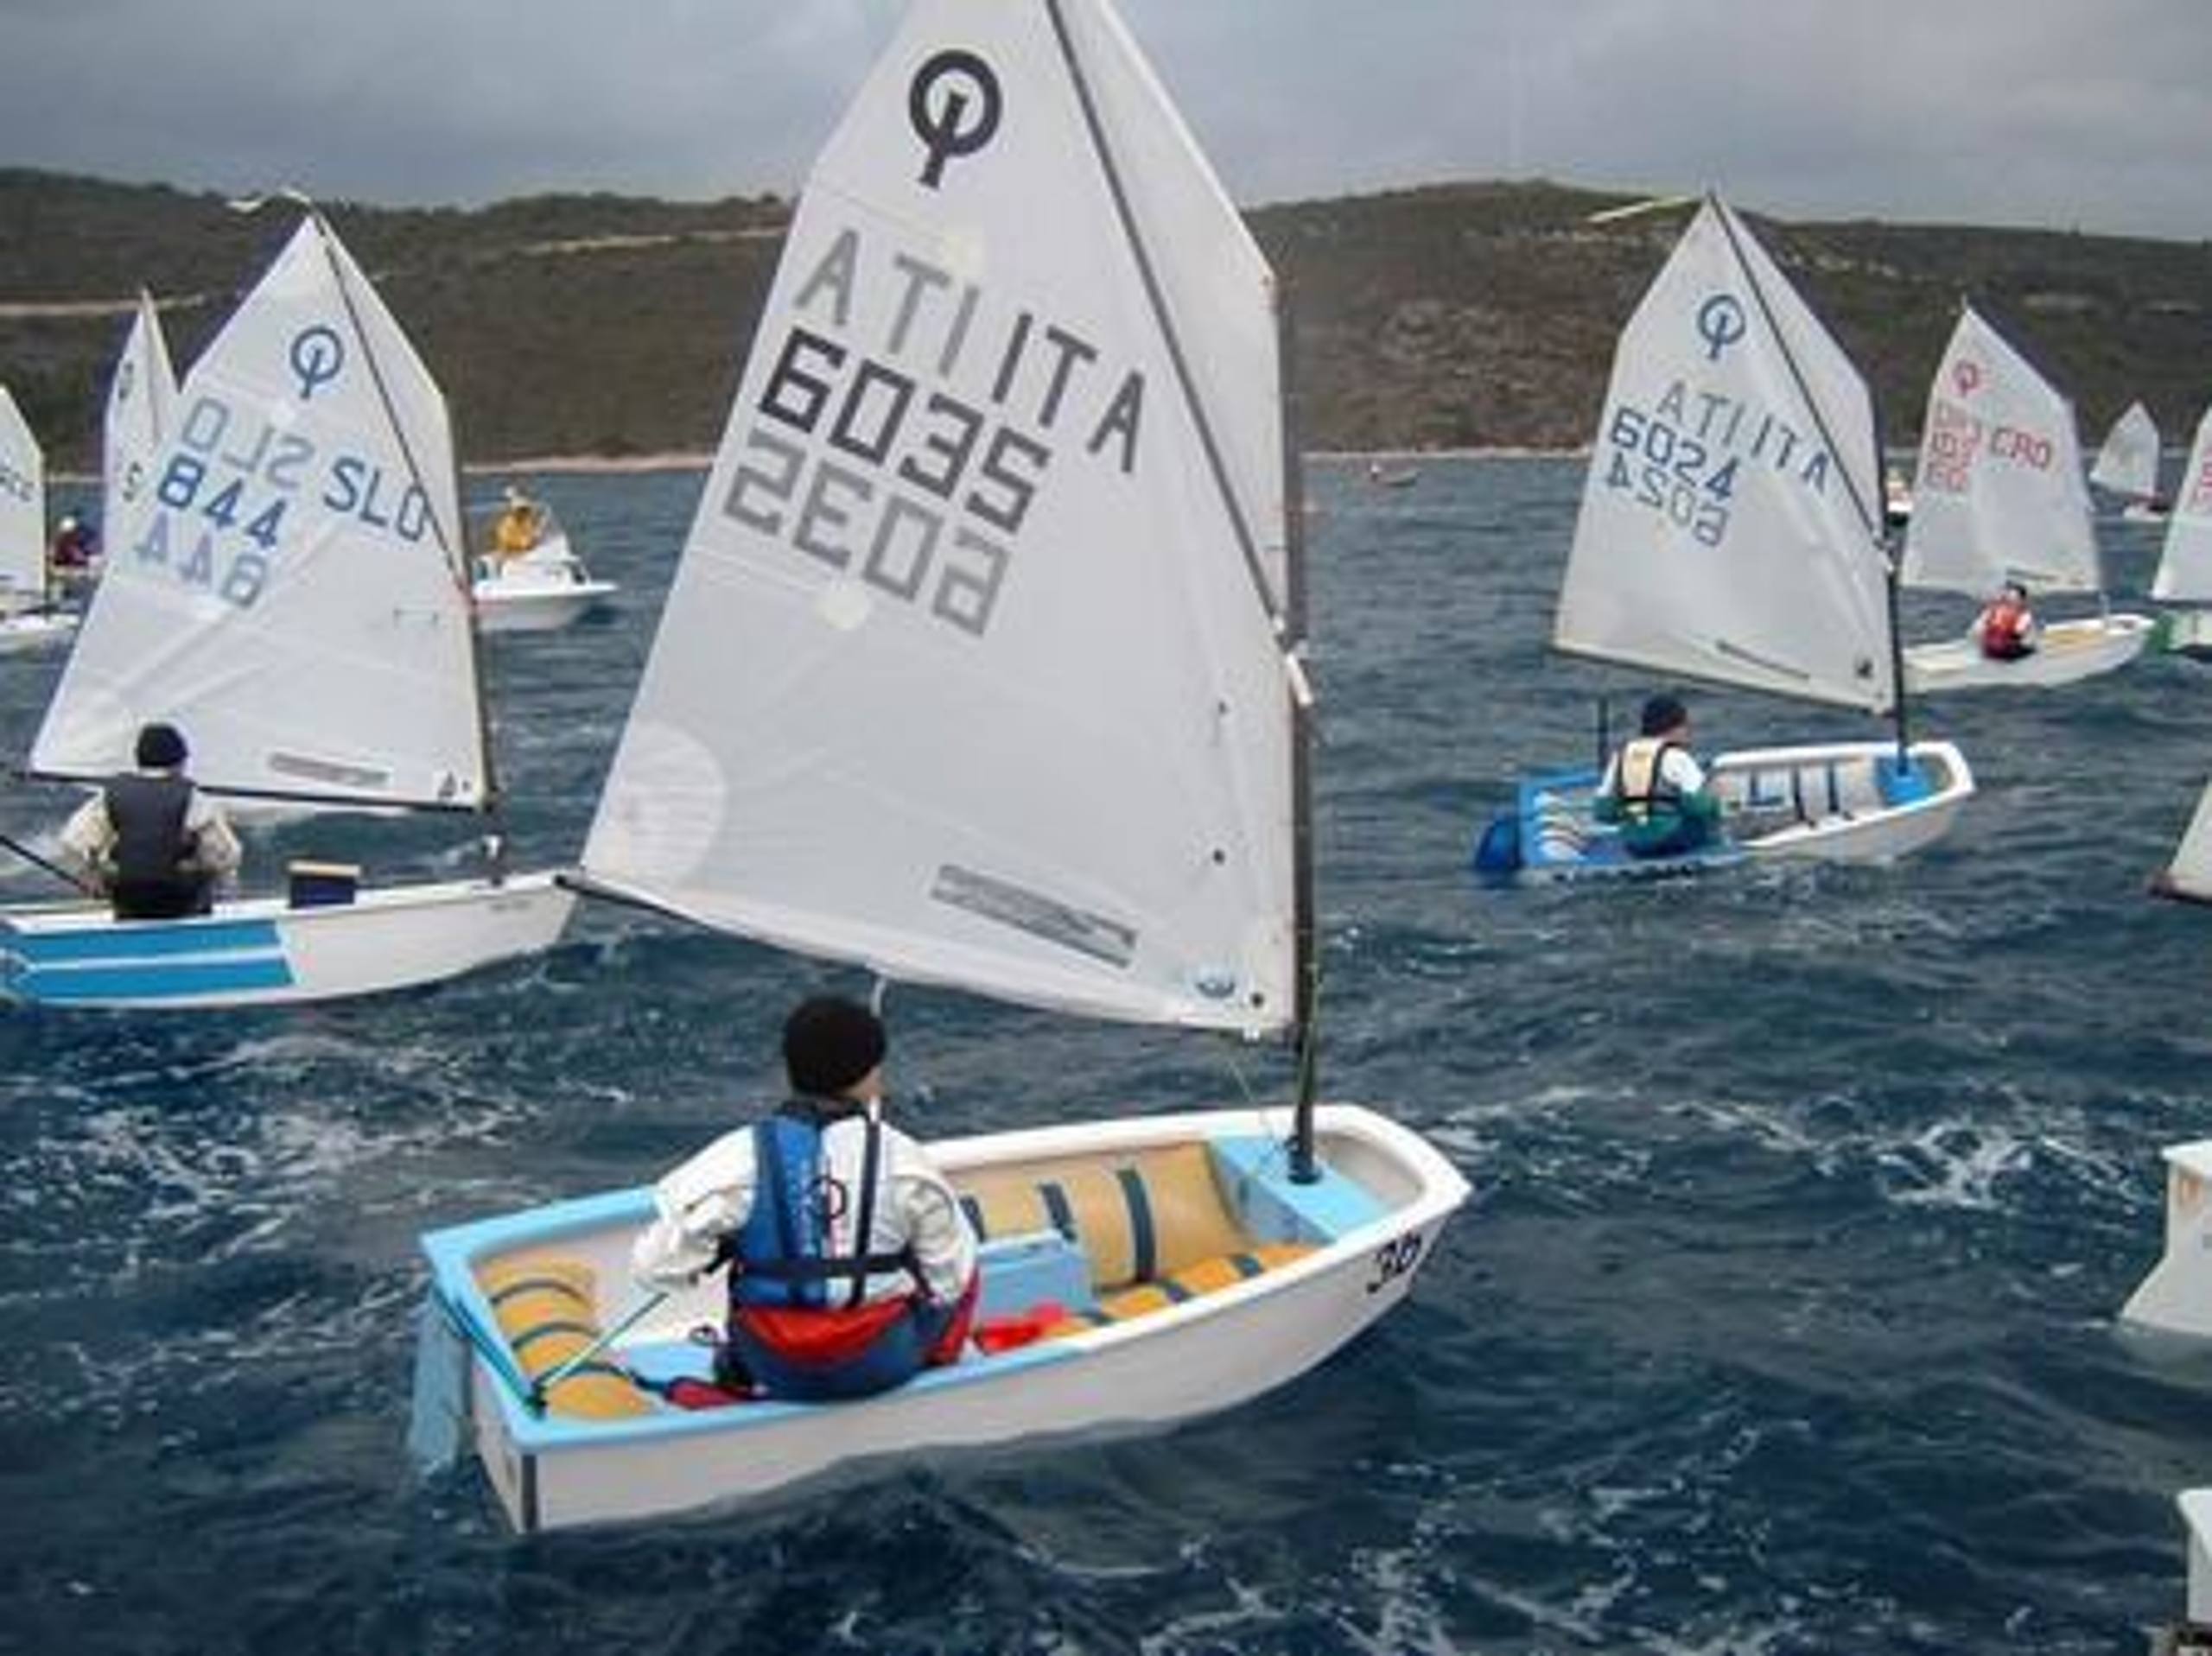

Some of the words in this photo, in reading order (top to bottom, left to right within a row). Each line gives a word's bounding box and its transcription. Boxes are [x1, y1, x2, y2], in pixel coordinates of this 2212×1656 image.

[759, 327, 1051, 534] 6035
[994, 312, 1144, 473] ITA
[156, 451, 286, 549] 844
[323, 454, 432, 542] SLO
[1611, 406, 1739, 501] 6024
[1751, 415, 1828, 494] ITA
